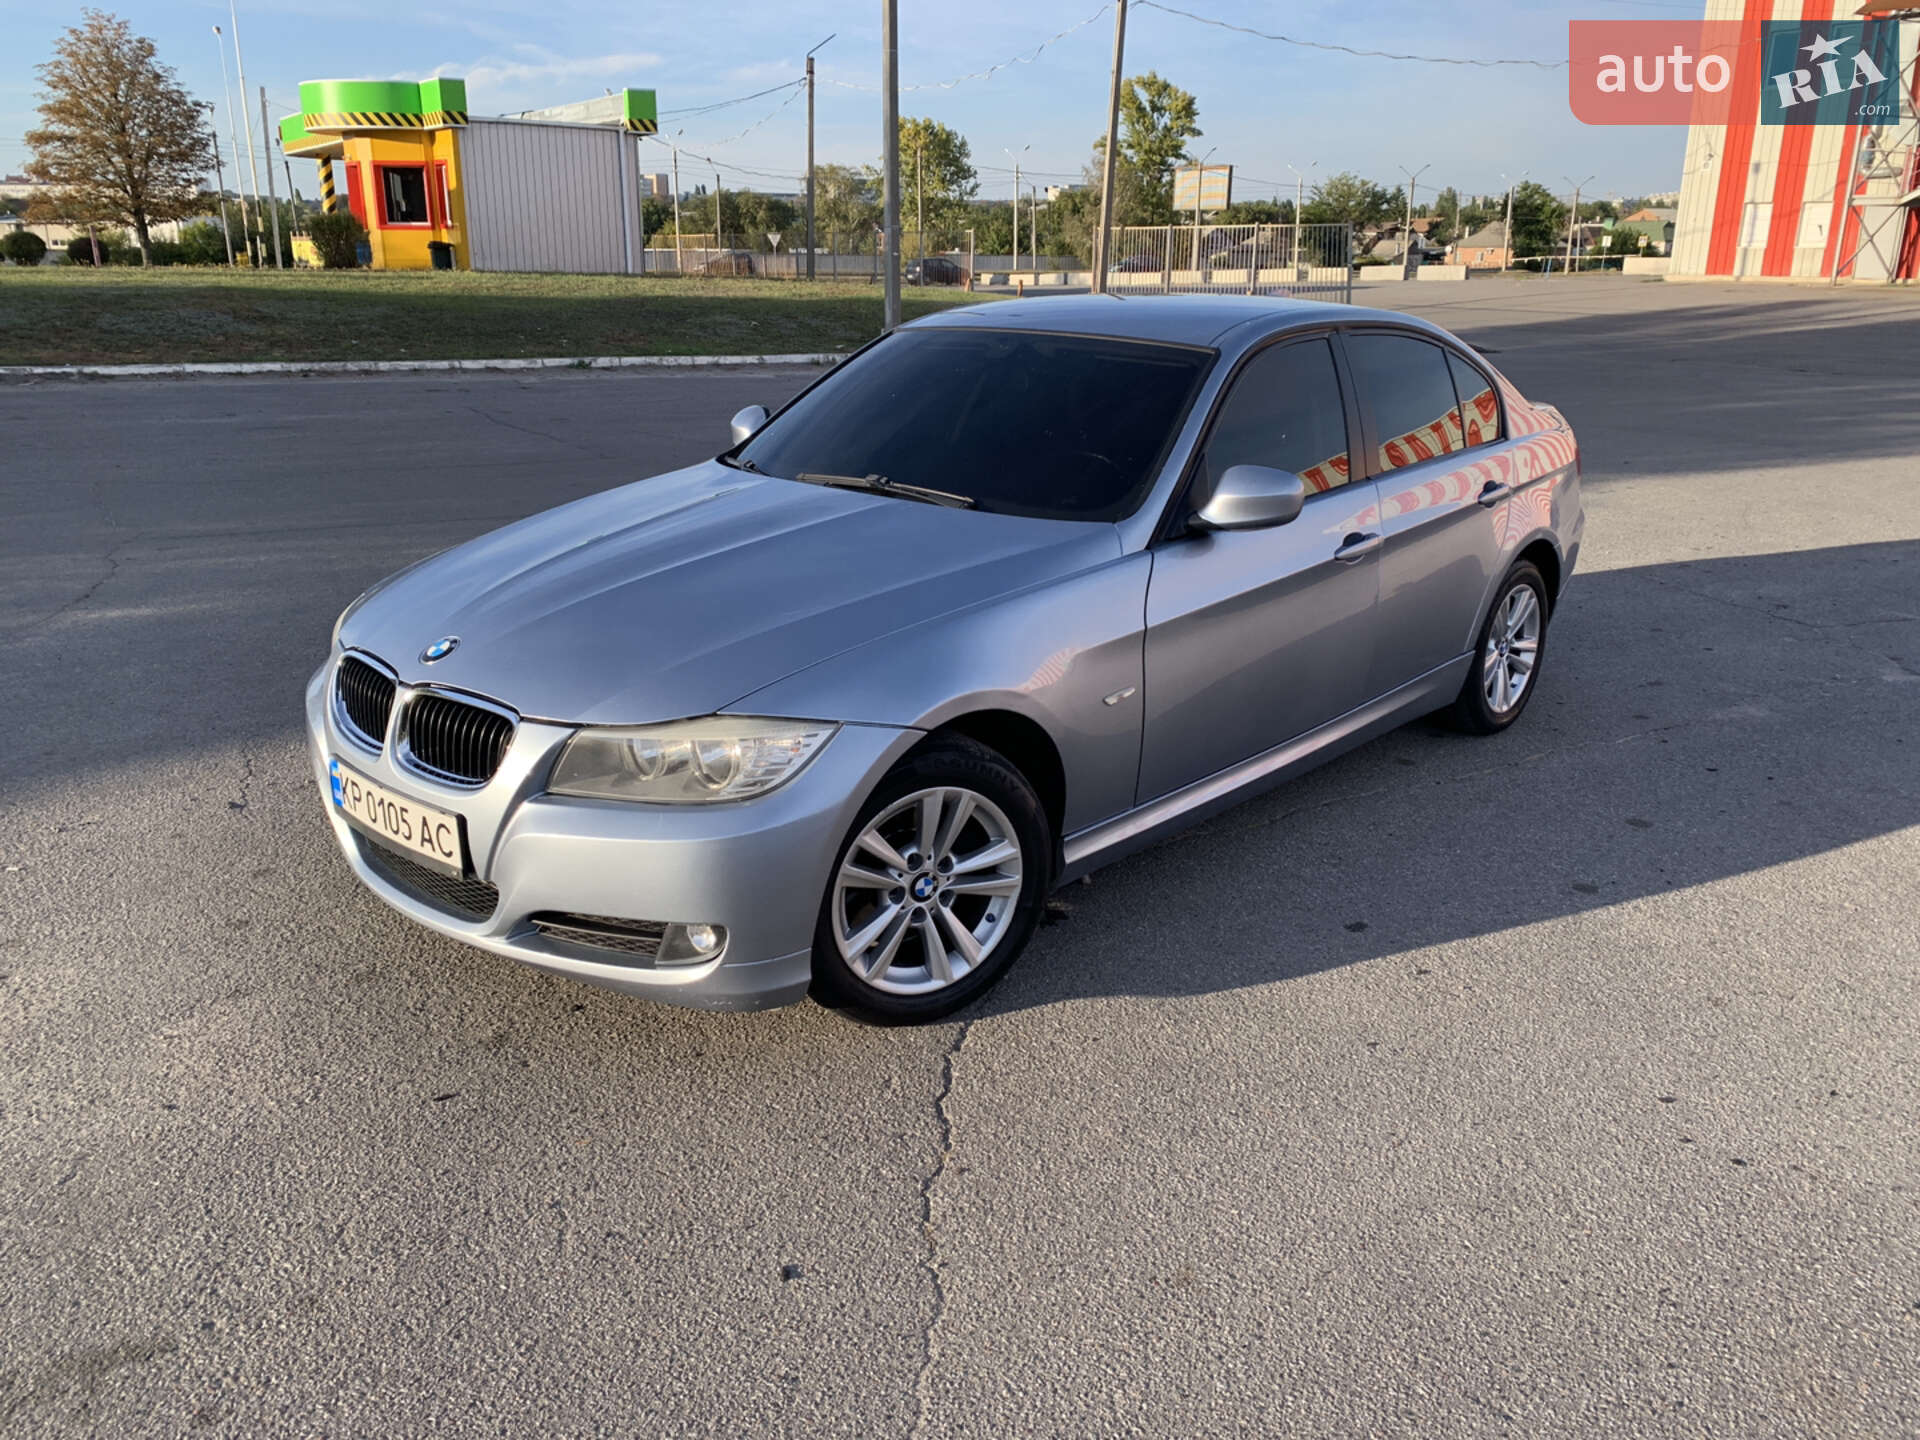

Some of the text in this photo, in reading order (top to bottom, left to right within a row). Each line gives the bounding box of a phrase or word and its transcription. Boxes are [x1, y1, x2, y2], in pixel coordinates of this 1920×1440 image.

[340, 771, 454, 858] KP 0105 AC
